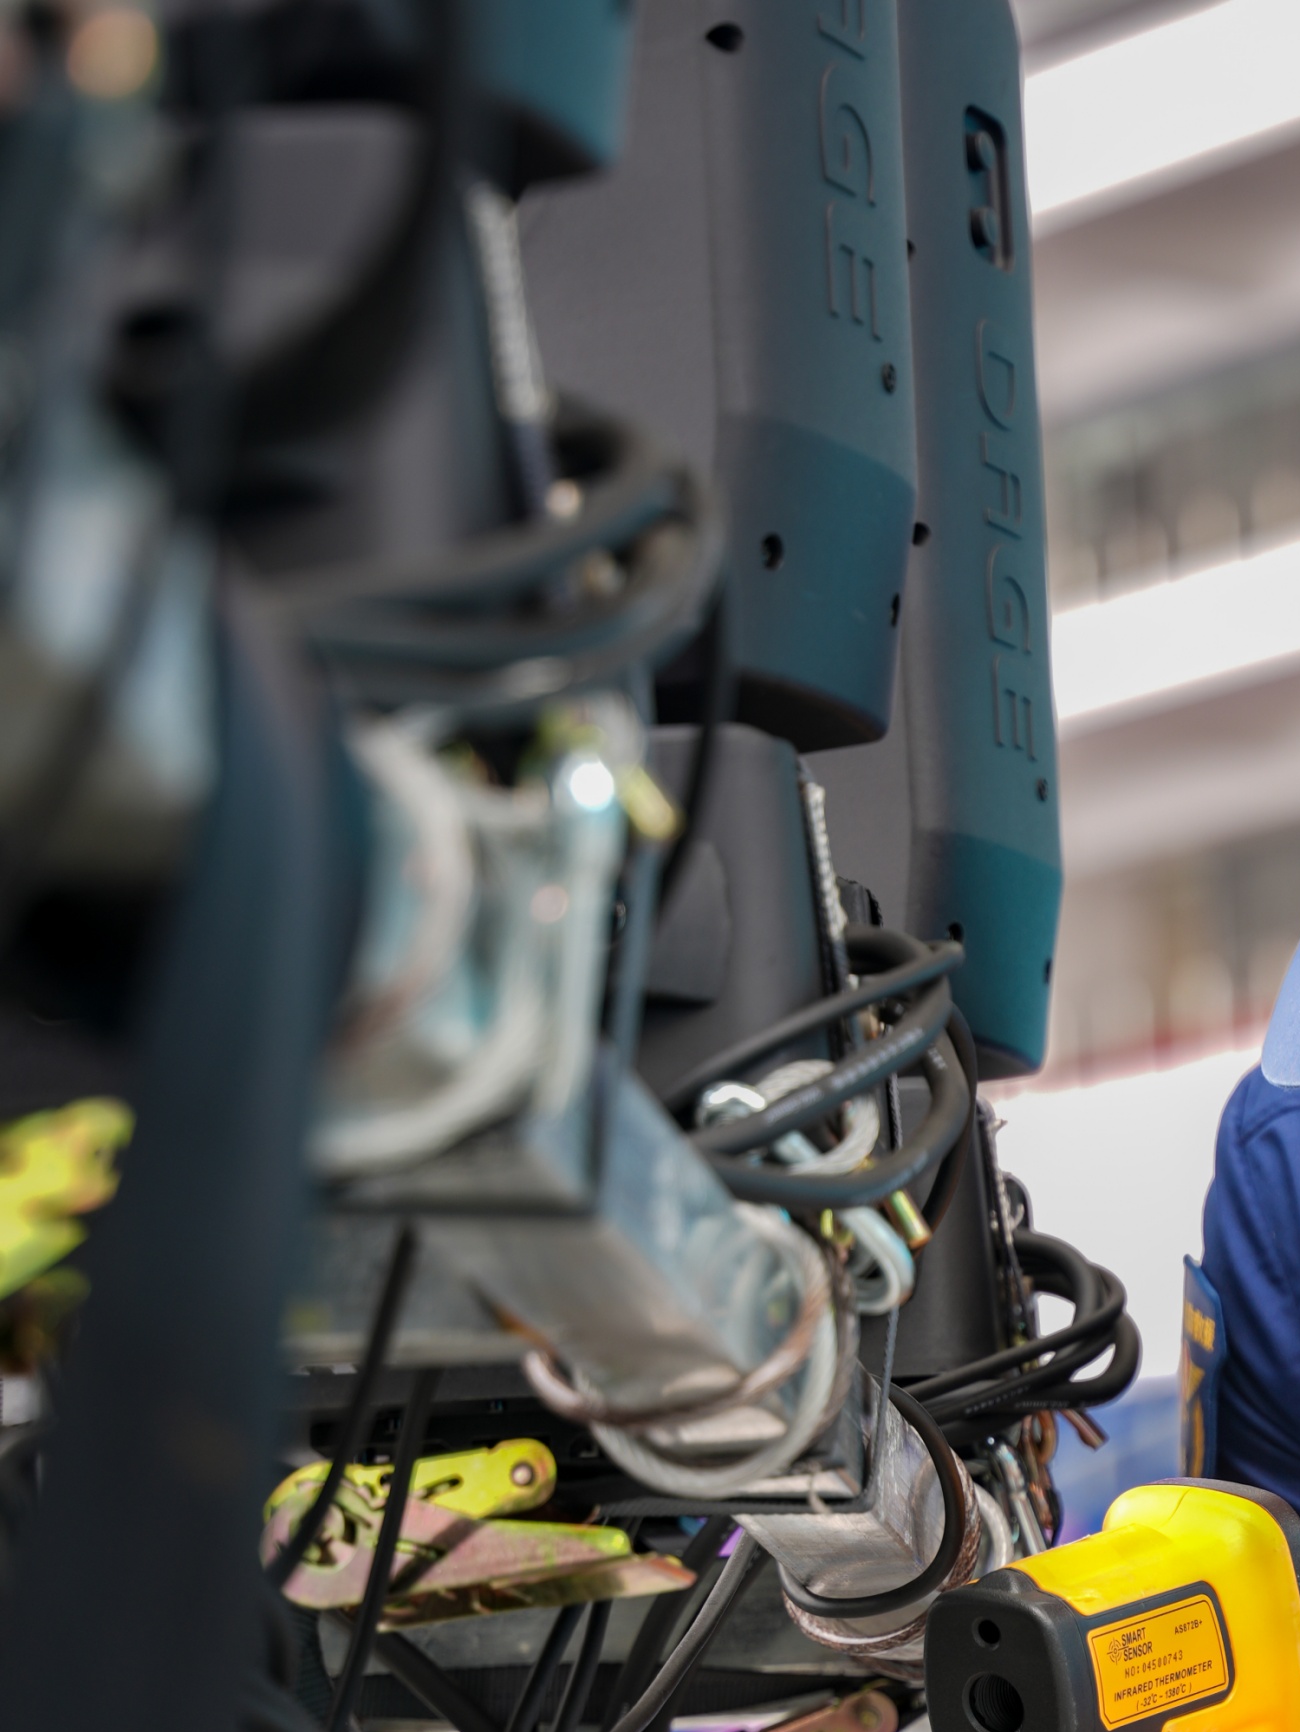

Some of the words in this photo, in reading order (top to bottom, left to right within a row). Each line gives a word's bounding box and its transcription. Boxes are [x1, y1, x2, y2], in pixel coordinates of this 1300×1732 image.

[975, 317, 1039, 763] DAGE
[1121, 1627, 1146, 1647] SMART
[1174, 1619, 1203, 1635] AS872B+
[1123, 1641, 1153, 1662] SENSOR
[1114, 1681, 1154, 1702] INFRARED
[1155, 1660, 1213, 1688] THERMOMETER
